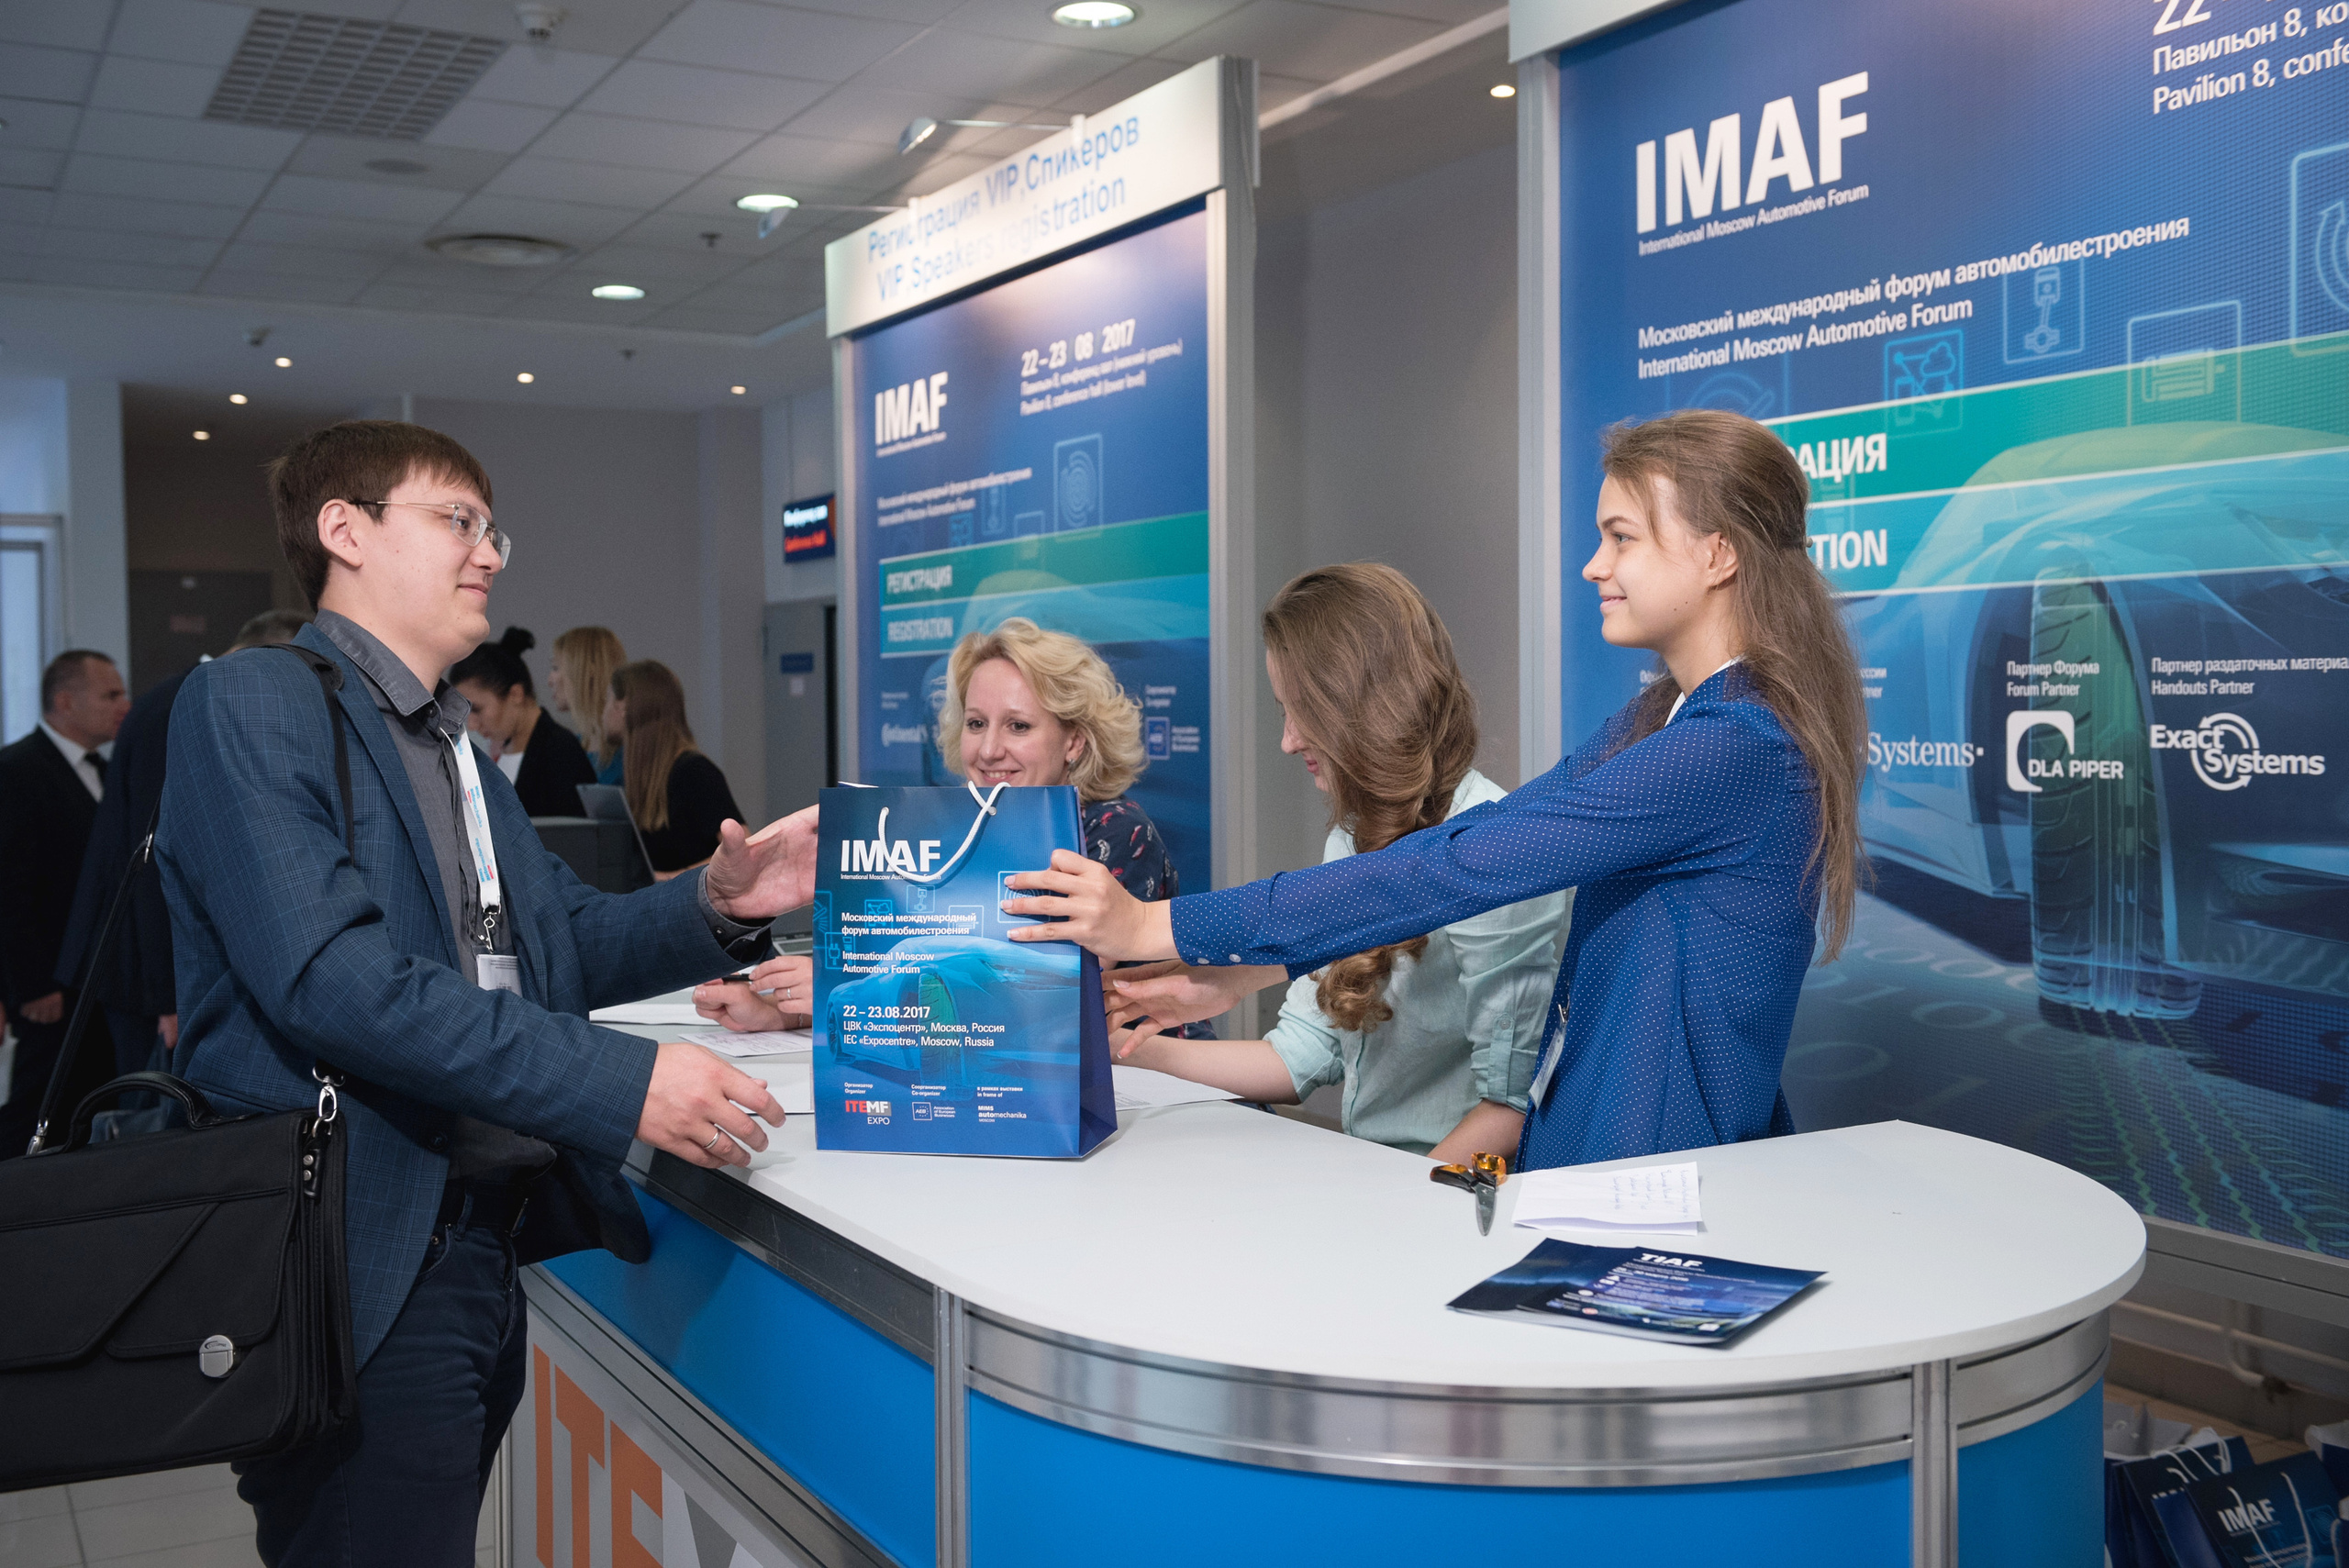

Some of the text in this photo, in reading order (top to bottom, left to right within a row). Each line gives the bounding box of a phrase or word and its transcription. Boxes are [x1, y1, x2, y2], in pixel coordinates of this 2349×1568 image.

[2153, 1, 2349, 75] Павильон 8, ко
[2153, 72, 2246, 115] Pavilion
[2252, 58, 2277, 88] 8,
[1636, 71, 1869, 235] IMAF
[1639, 184, 1870, 257] International Moscow Automotive Forum
[1639, 217, 2189, 350] Московский международный форум автомобилестроения
[1101, 318, 1136, 354] 2017
[1639, 299, 1973, 380] International Moscow Automotive Forum
[875, 371, 948, 446] IMAF
[1789, 433, 1887, 484] АЦИЯ
[1810, 528, 1887, 570] TION
[2006, 660, 2100, 679] Партнер Форума
[2151, 656, 2349, 676] Партнер раздаточных материа
[2006, 681, 2081, 697] Forum Partner
[2151, 678, 2255, 695] Handouts Partner
[2150, 724, 2224, 750] Exact
[1867, 731, 1976, 773] Systems
[2028, 759, 2124, 780] DLA PIPER
[2204, 749, 2326, 779] Systems
[841, 840, 941, 873] IMAF
[841, 912, 976, 925] Московский международный
[841, 925, 970, 937] форум автомобилестроения
[842, 951, 935, 962] International Moscow
[842, 963, 920, 974] Automotive Forum
[842, 1005, 857, 1018] 22
[867, 1006, 930, 1018] 23.08.2017
[843, 1020, 1005, 1034] ЦВК «Экспоцентр», Москва, Россия
[843, 1034, 995, 1048] IEC «Expocentre», Moscow, Russia
[845, 1099, 889, 1114] ITEMF
[867, 1117, 890, 1126] EXPO
[1641, 1253, 1703, 1267] TIAF
[2217, 1498, 2276, 1532] IMAF
